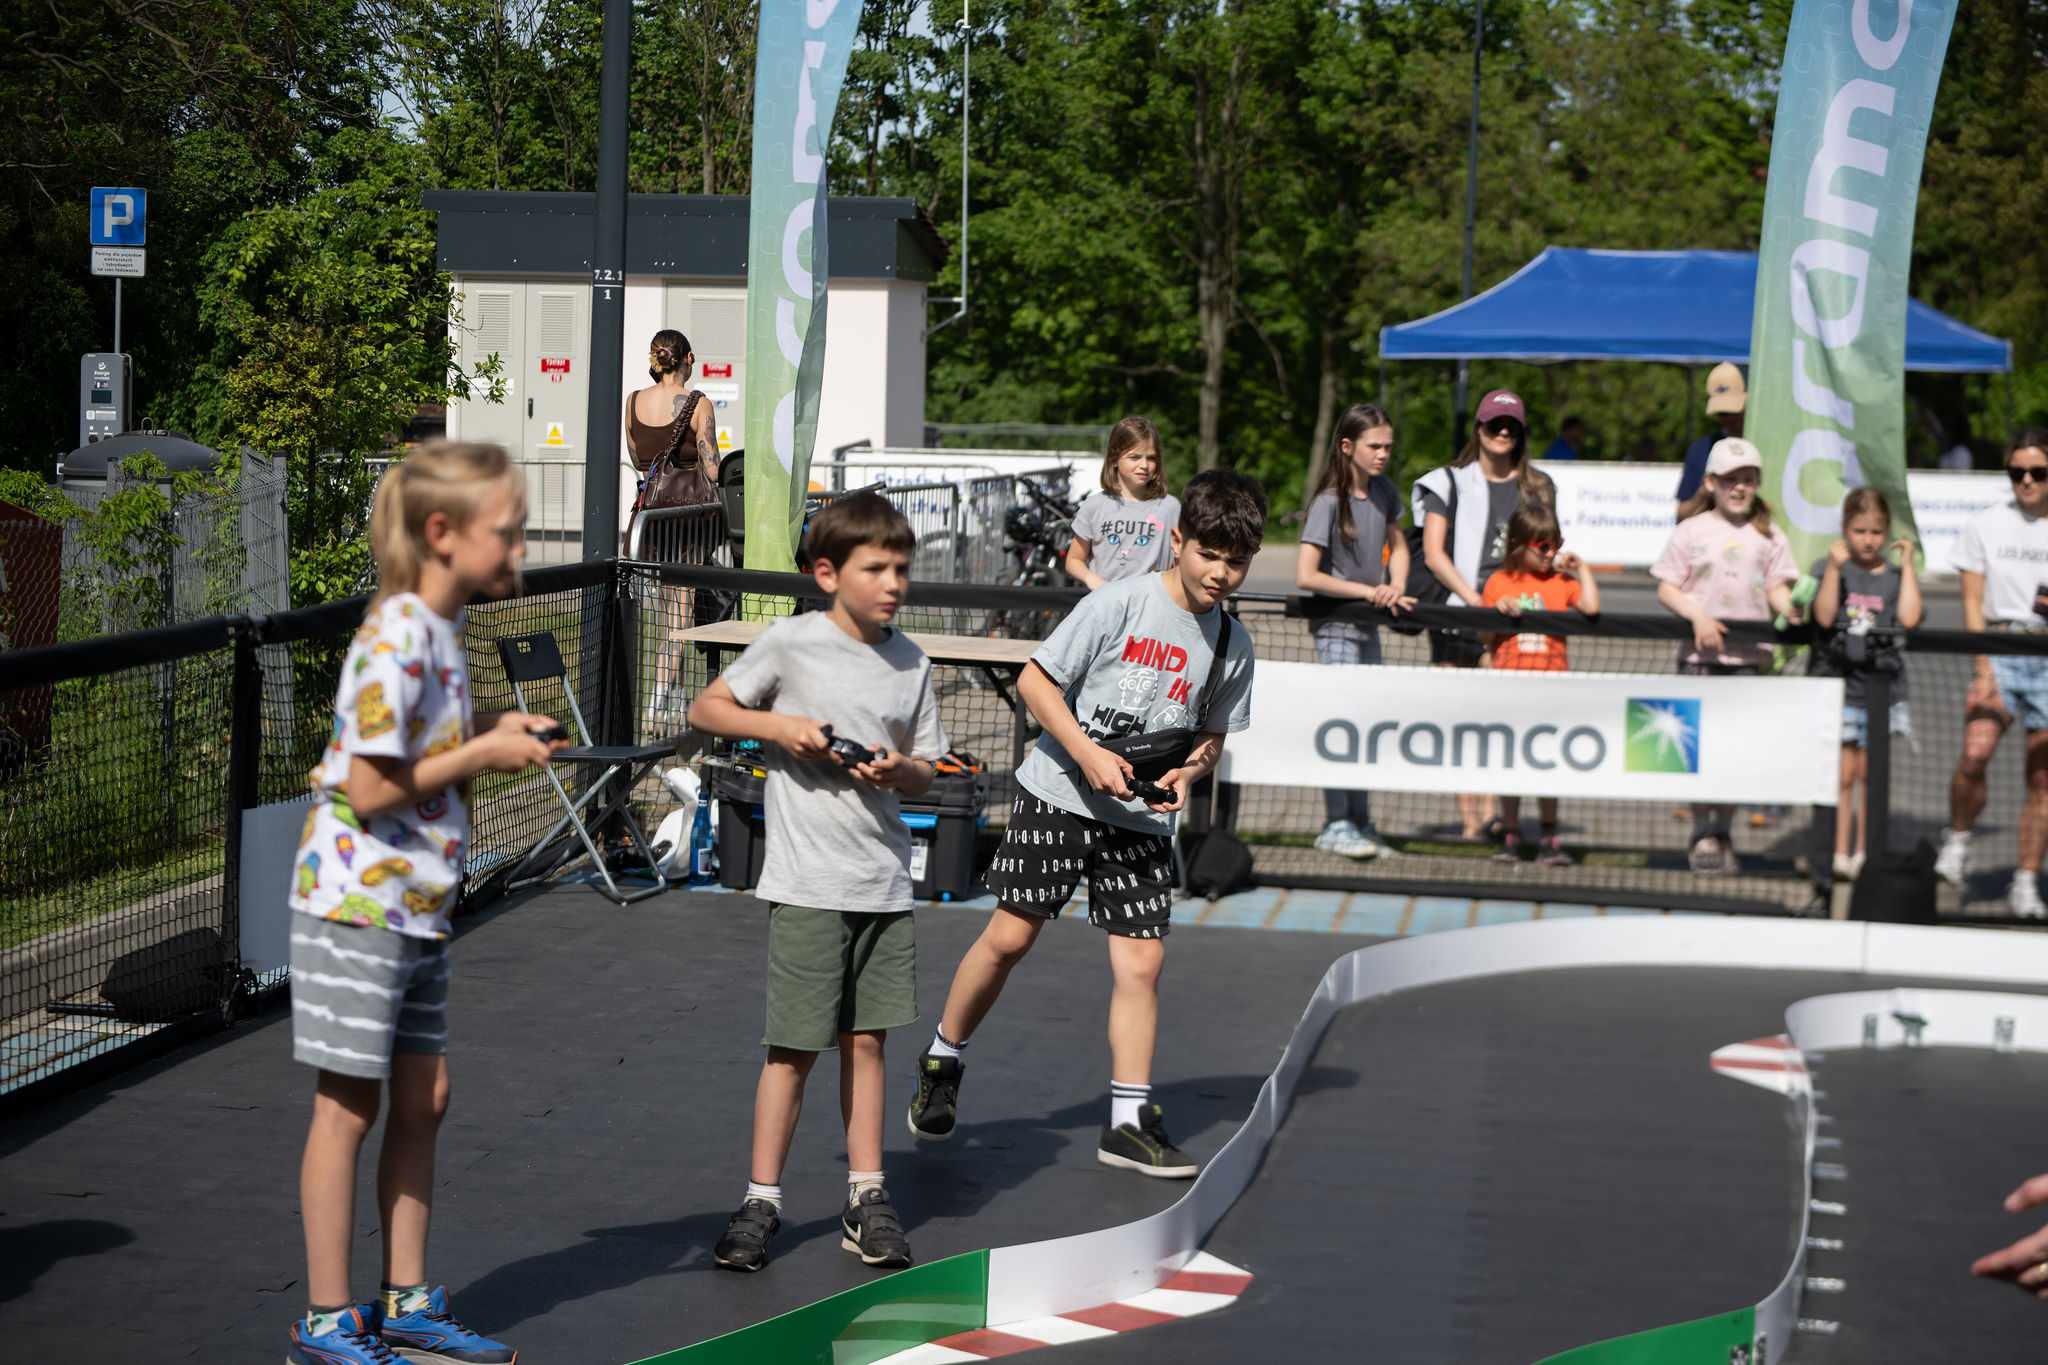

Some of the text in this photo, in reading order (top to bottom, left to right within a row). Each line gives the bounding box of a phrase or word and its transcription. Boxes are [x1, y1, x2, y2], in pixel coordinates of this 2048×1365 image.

[104, 195, 134, 237] P
[604, 289, 611, 300] 1
[1100, 520, 1155, 538] #CUTE
[1121, 635, 1188, 673] MIND
[1091, 704, 1147, 736] HIGH
[1314, 718, 1607, 772] aramco
